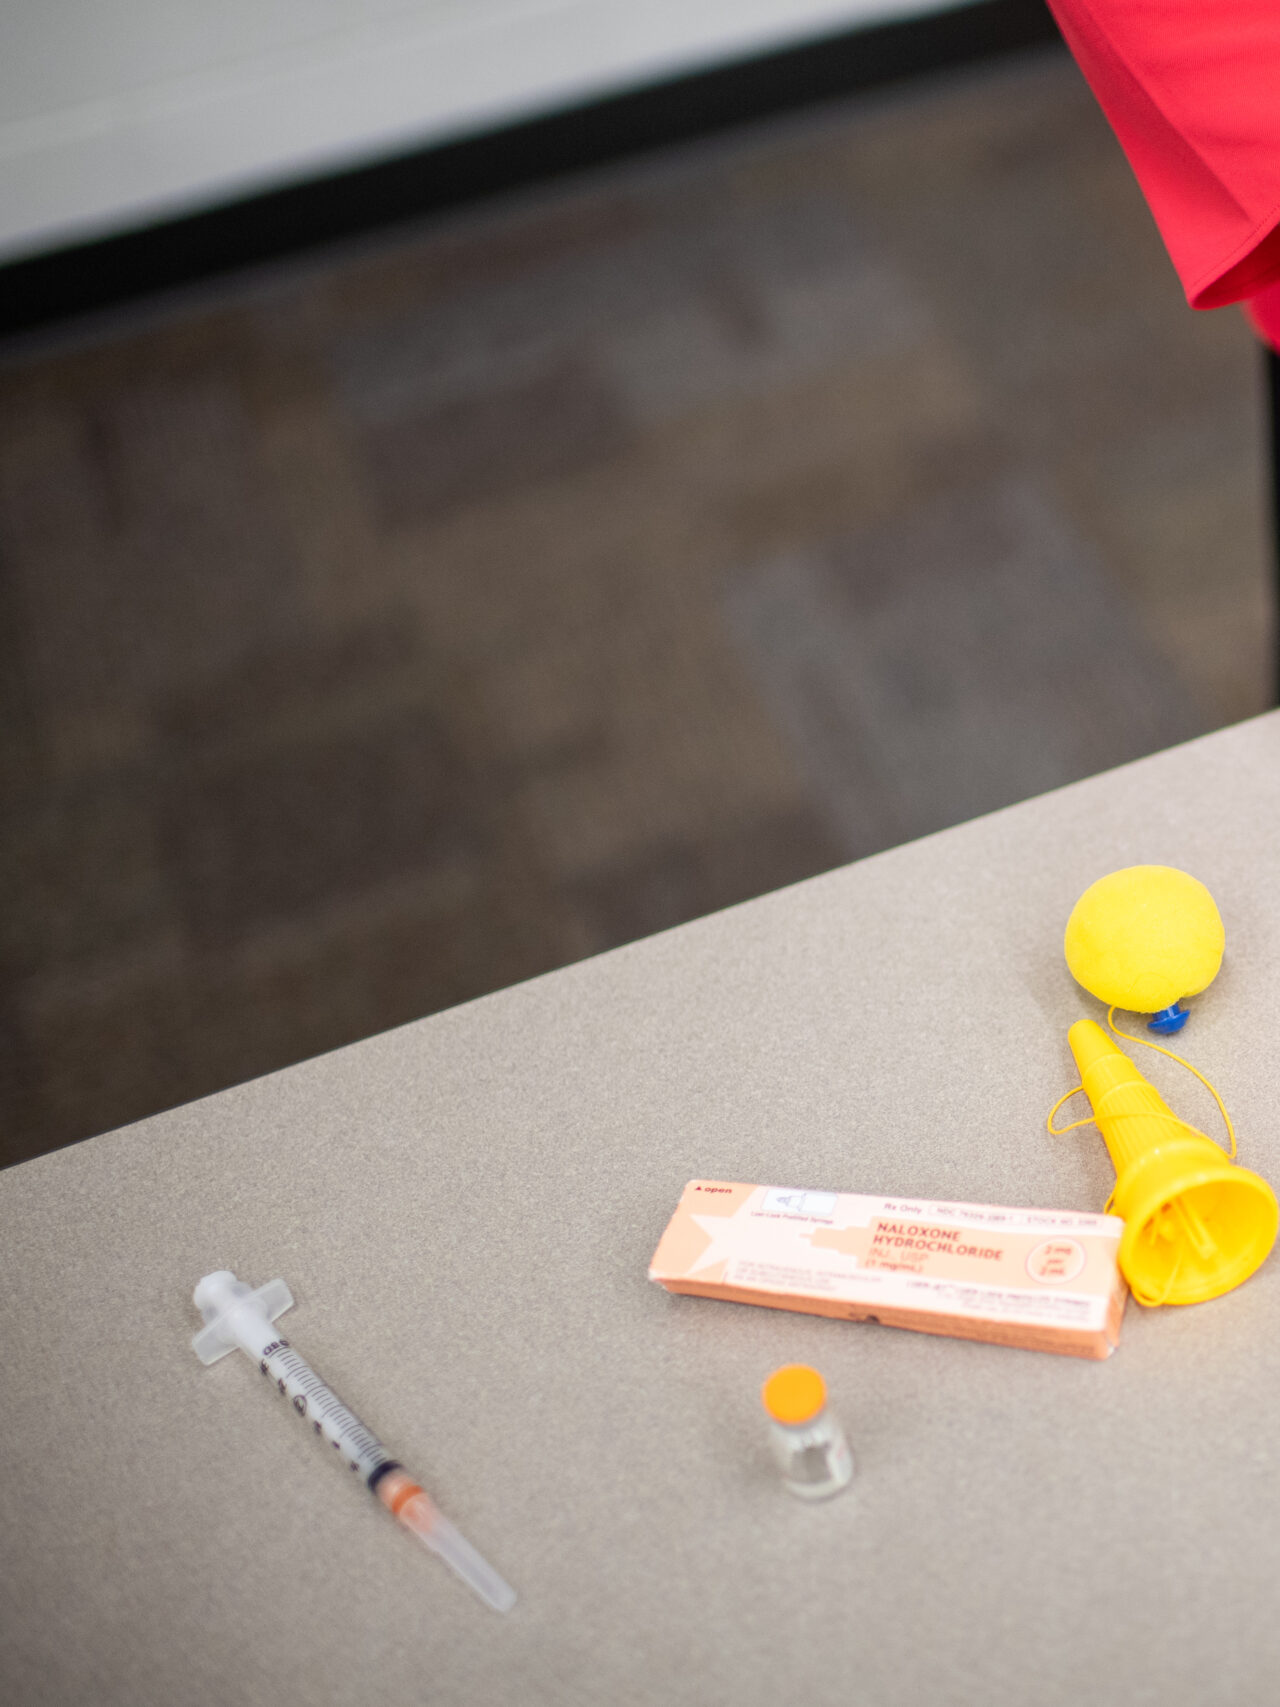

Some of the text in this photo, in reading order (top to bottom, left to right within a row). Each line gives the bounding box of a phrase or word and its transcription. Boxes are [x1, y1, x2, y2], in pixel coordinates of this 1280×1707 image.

[704, 1186, 733, 1194] open
[900, 1203, 923, 1215] Only
[877, 1222, 962, 1242] NALOXONE
[873, 1234, 1004, 1262] HYDROCHLORIDE
